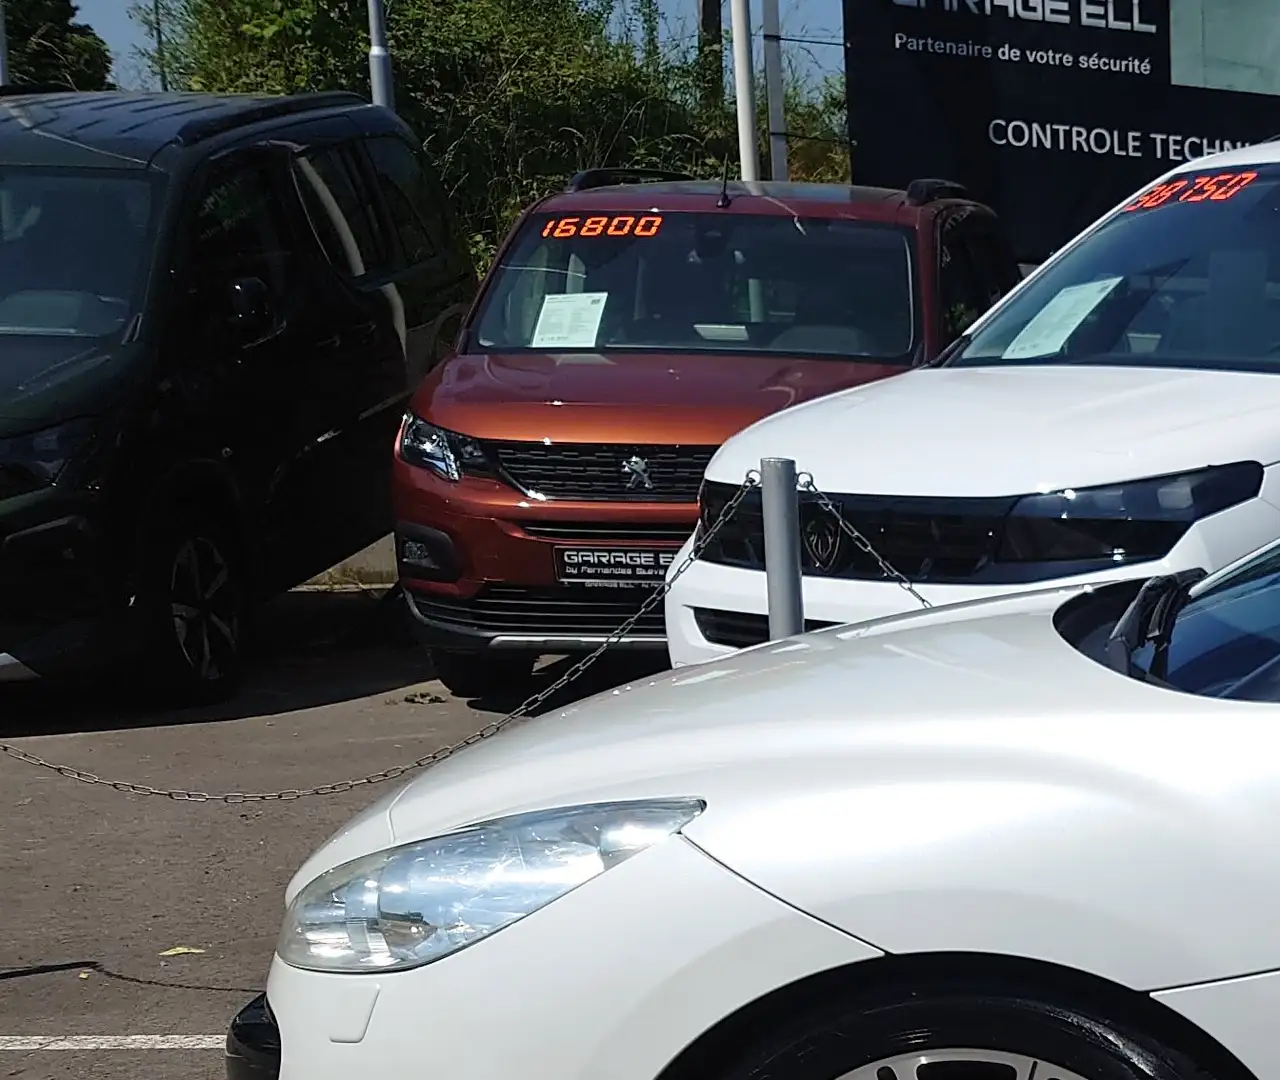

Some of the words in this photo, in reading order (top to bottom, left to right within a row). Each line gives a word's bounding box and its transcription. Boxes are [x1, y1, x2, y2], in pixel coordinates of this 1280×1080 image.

[892, 0, 1071, 25] AGE
[1080, 0, 1157, 33] ELL
[894, 33, 992, 58] Partenaire
[998, 44, 1021, 61] de
[1026, 49, 1074, 67] votre
[1078, 53, 1151, 75] sécurité
[988, 119, 1143, 157] CONTROLE
[1149, 133, 1250, 161] TECH
[1178, 172, 1258, 202] 750
[542, 215, 662, 238] 16800
[564, 551, 655, 565] GARAGE
[566, 566, 578, 575] by
[581, 566, 632, 575] Fernandes
